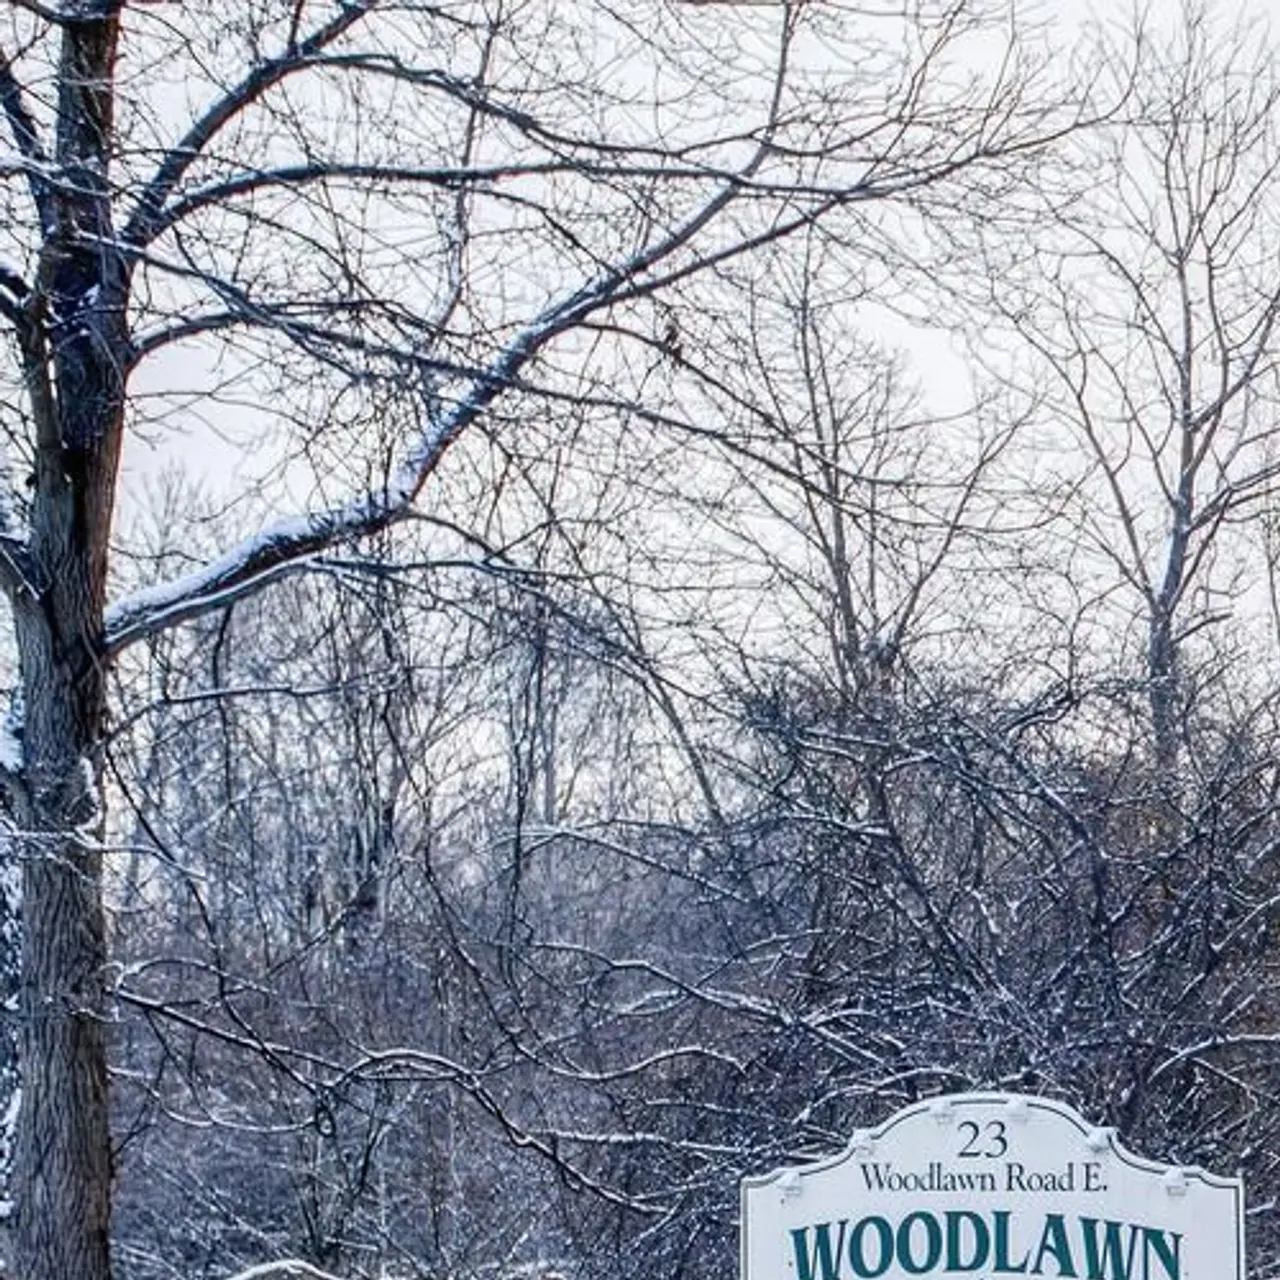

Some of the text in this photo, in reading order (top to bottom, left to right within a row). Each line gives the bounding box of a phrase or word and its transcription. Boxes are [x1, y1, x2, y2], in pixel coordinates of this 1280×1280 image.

[957, 1120, 1008, 1158] 23
[860, 1162, 1108, 1192] Woodlawn Road E.
